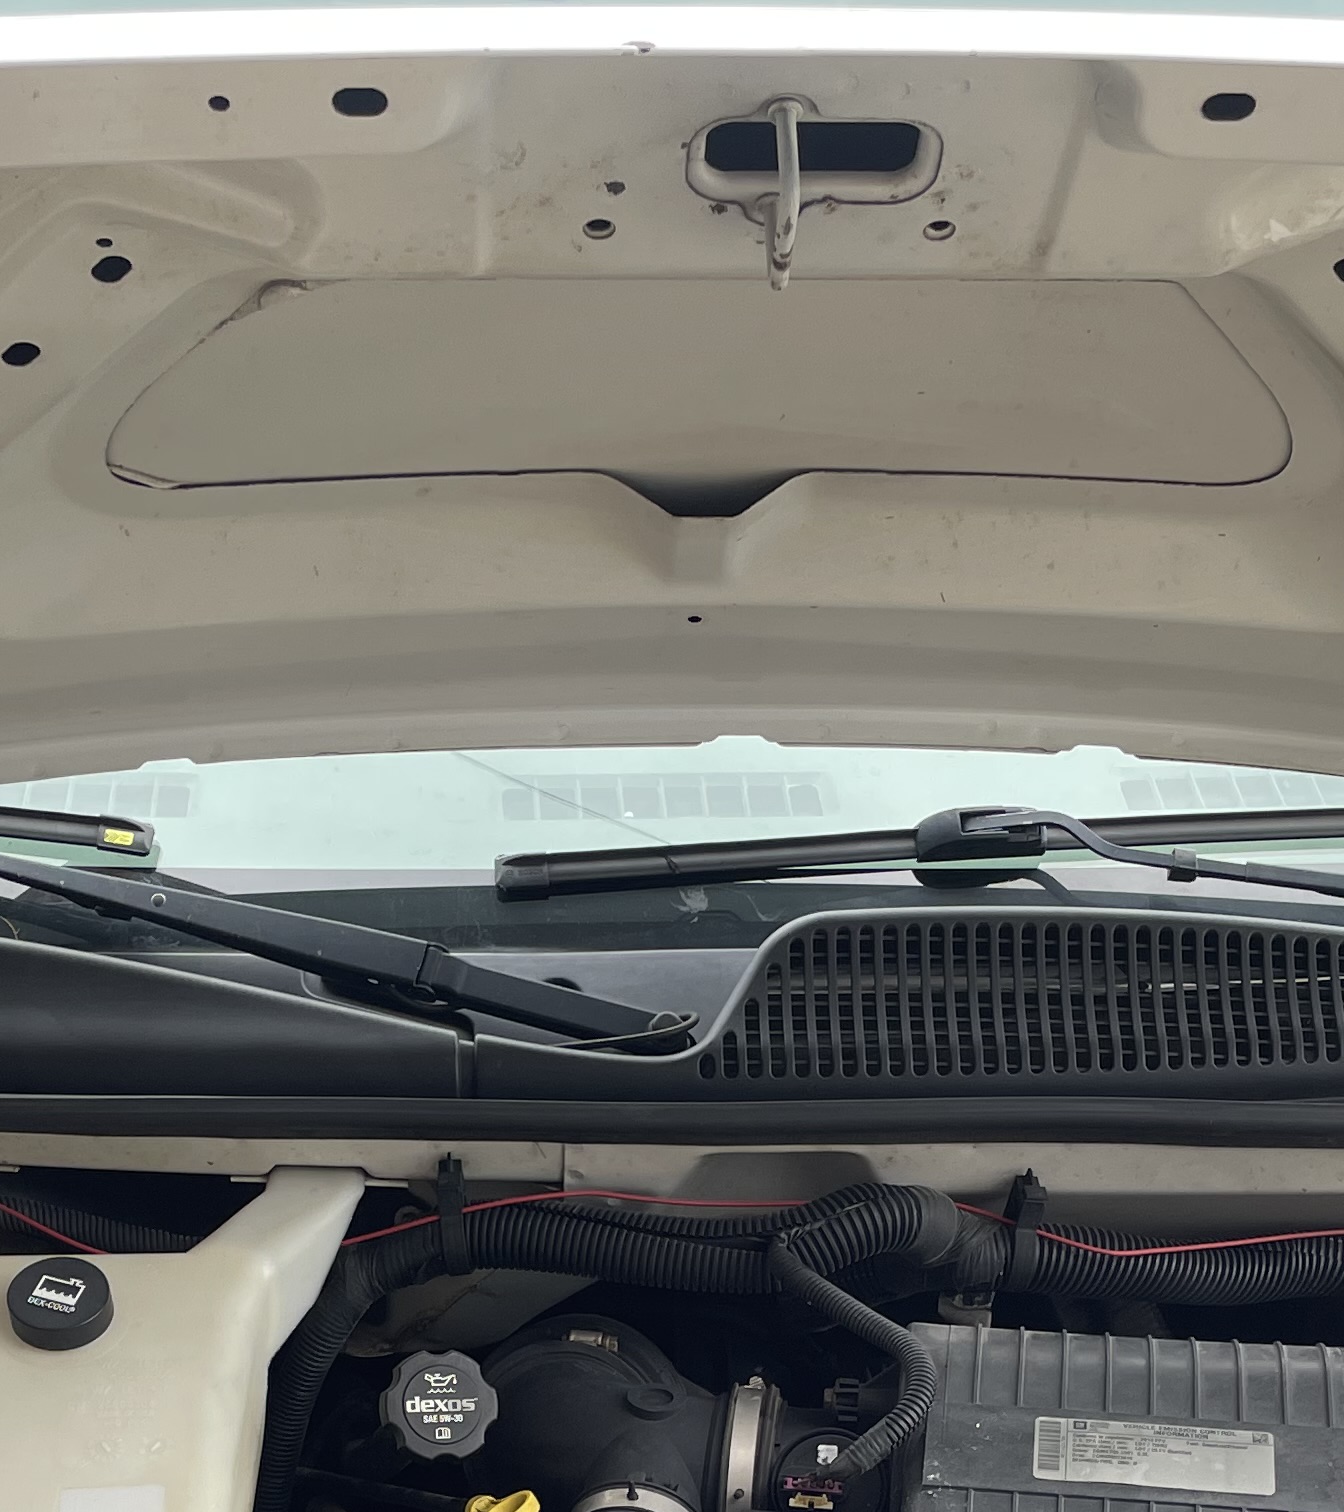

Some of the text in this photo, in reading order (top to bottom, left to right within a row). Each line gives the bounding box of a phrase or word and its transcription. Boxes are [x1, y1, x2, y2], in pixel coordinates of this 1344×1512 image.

[405, 1396, 478, 1413] dexos
[423, 1414, 464, 1423] SAE 5W-30
